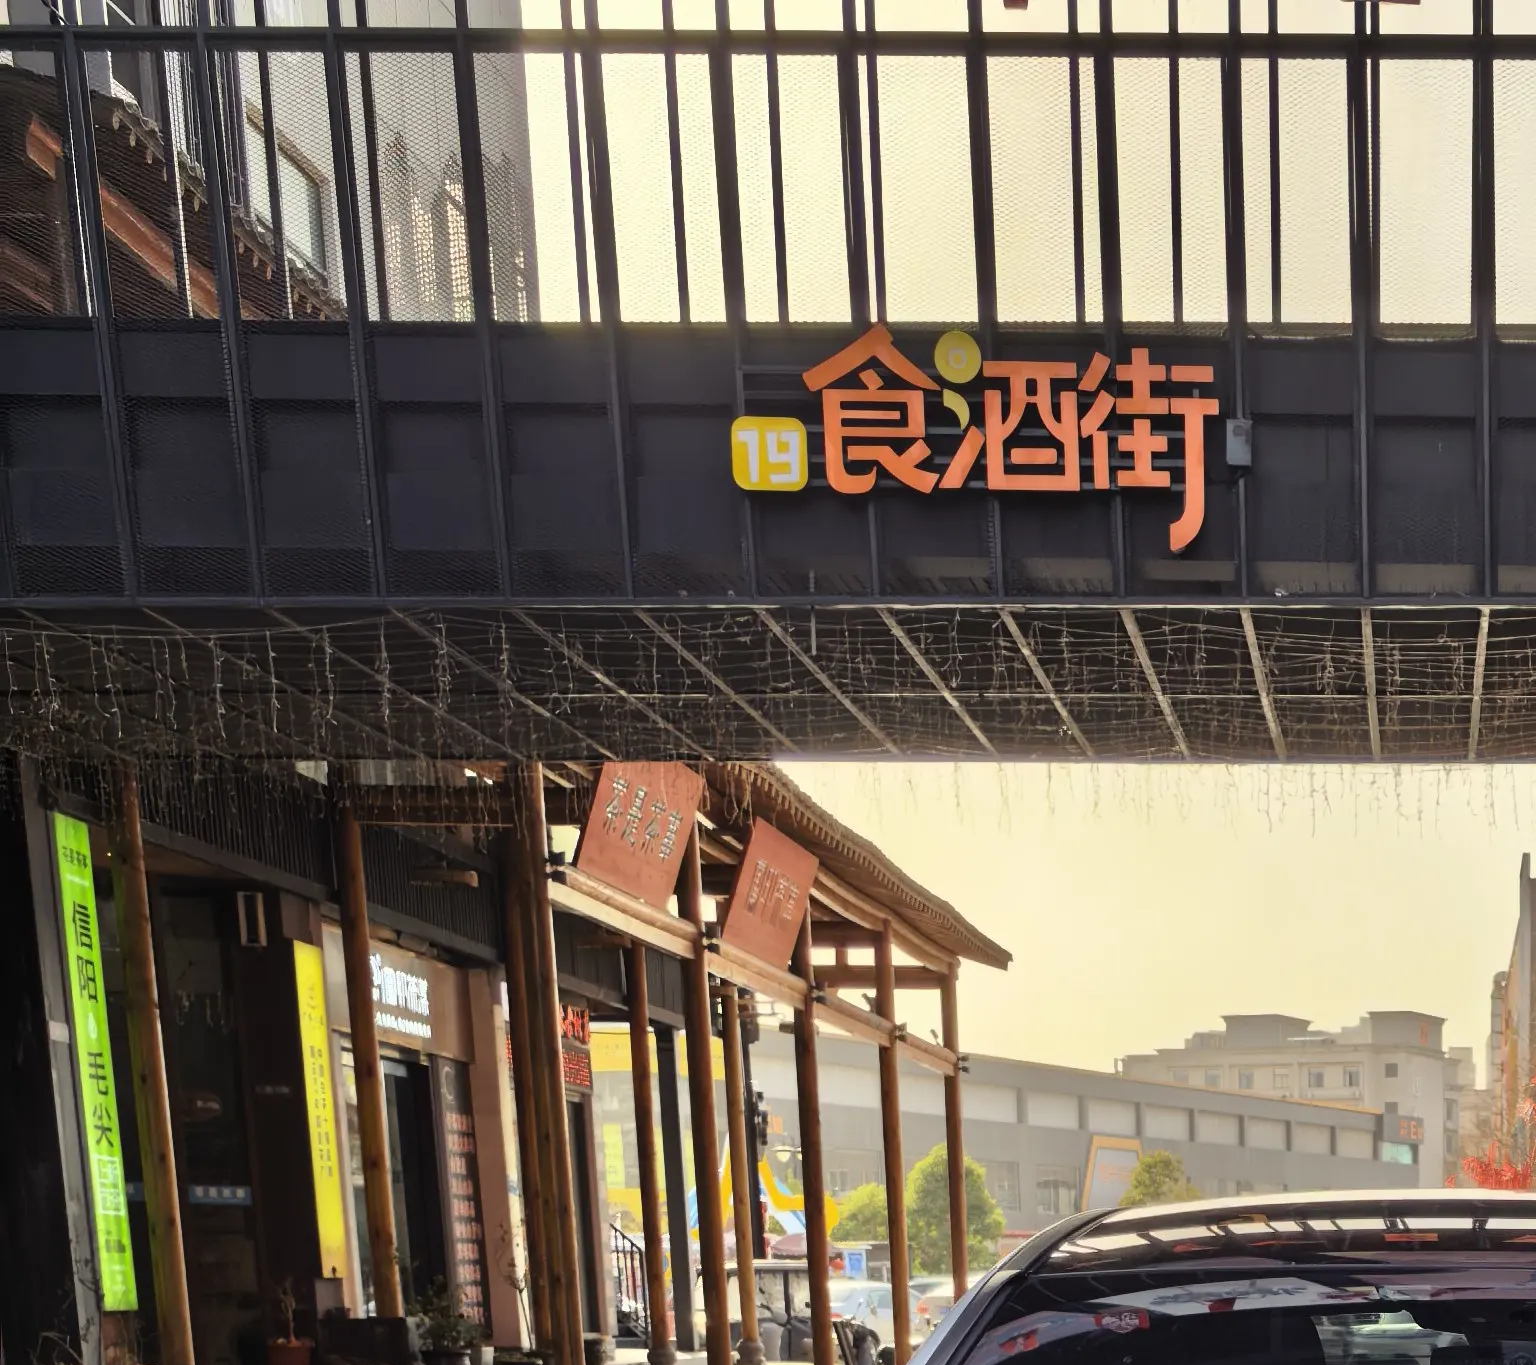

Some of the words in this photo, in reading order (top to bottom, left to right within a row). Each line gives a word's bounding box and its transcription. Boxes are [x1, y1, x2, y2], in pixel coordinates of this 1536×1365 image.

[735, 429, 800, 484] 19
[802, 323, 1219, 551] 食酒街
